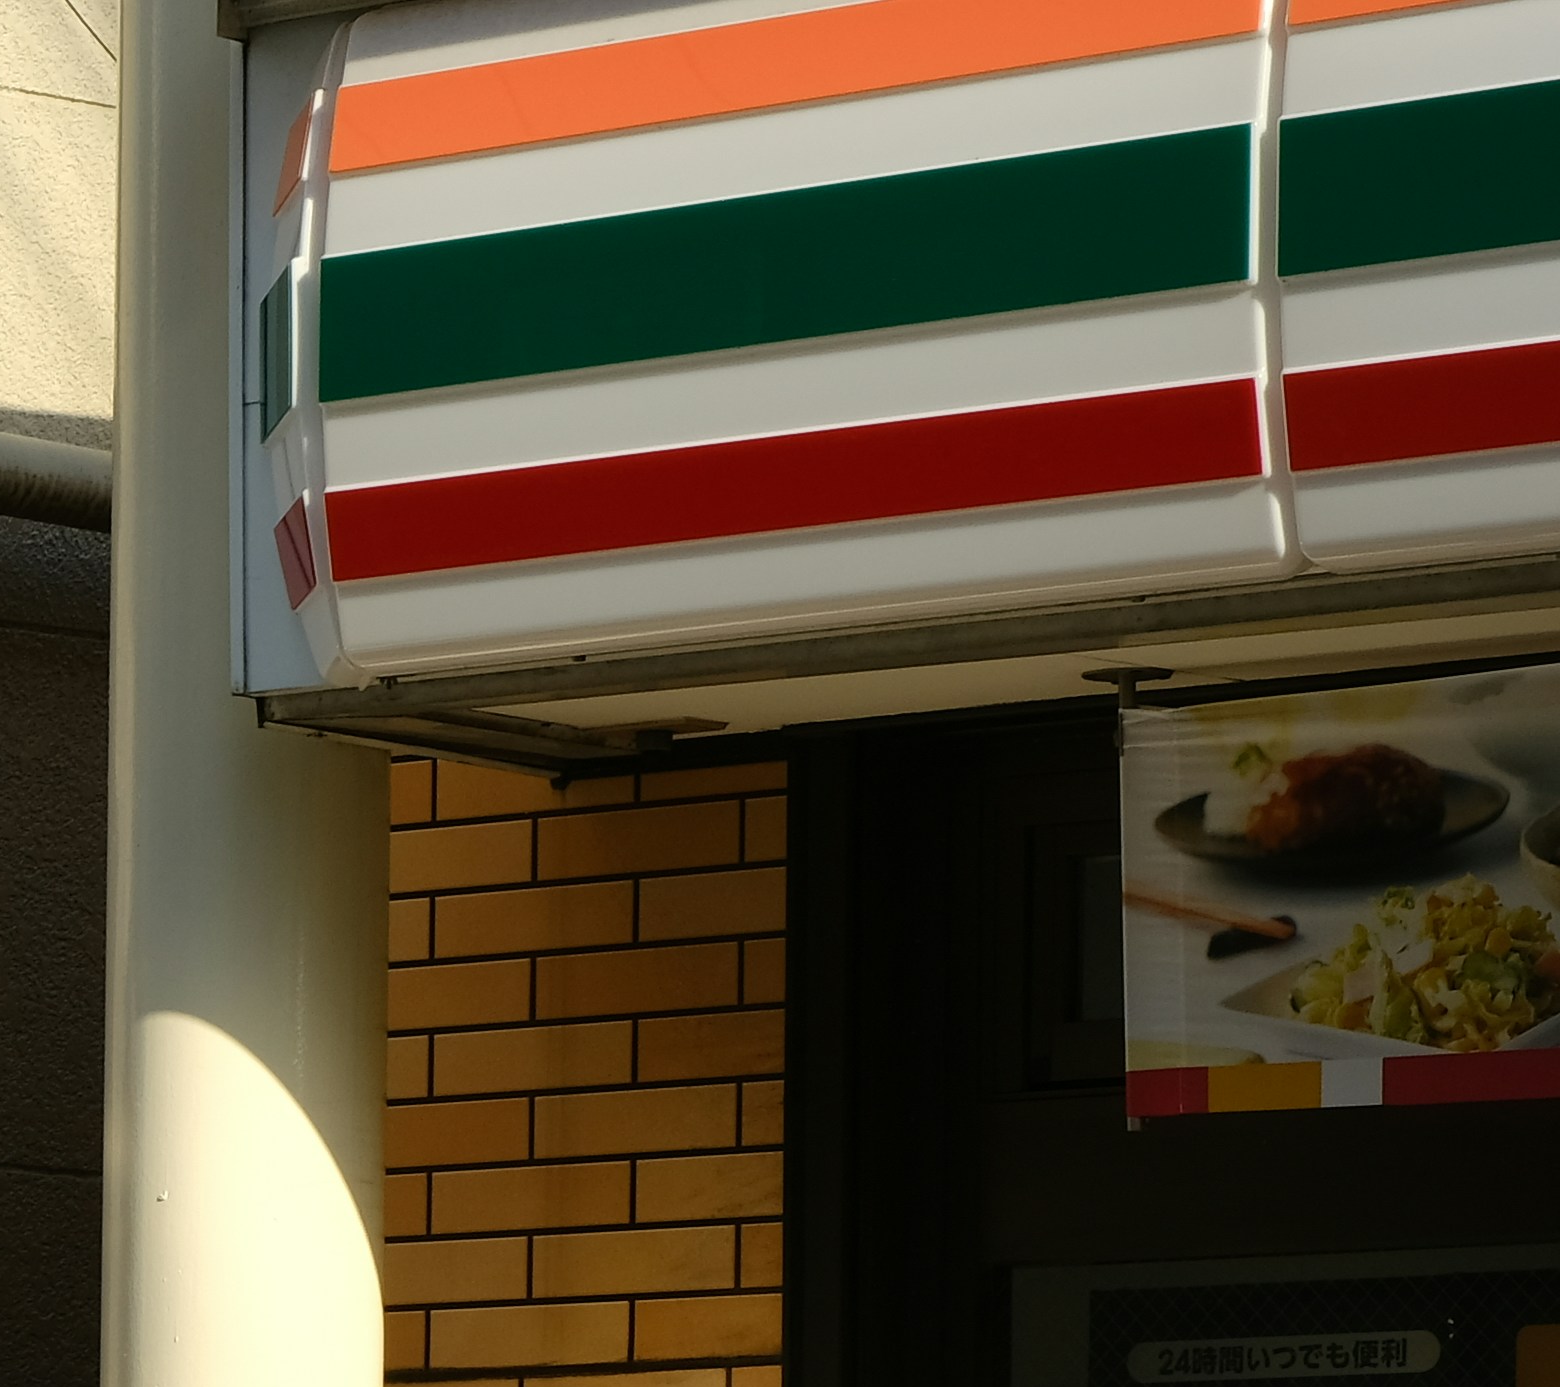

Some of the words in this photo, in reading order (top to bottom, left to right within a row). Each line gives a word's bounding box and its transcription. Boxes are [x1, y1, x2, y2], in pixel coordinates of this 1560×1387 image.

[1159, 1339, 1407, 1375] 24時間いつでも便利
